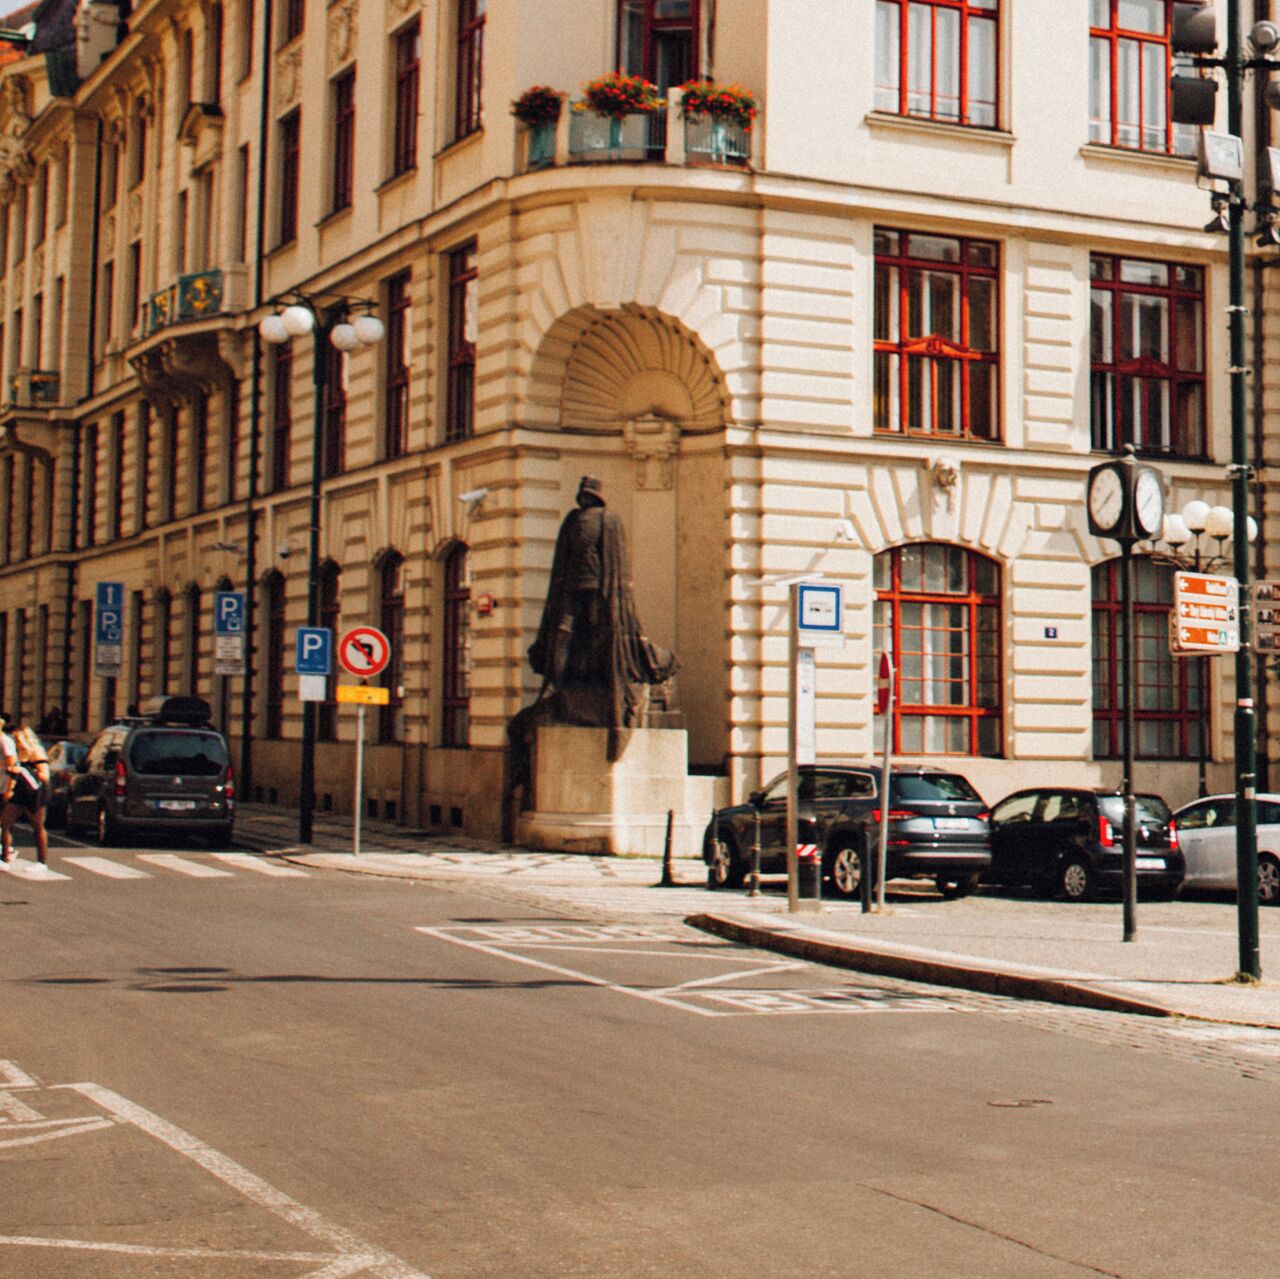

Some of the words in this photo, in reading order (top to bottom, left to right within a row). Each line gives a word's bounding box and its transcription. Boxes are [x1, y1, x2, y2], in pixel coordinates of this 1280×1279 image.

[220, 597, 238, 620] P
[102, 612, 117, 631] P
[303, 634, 323, 660] P
